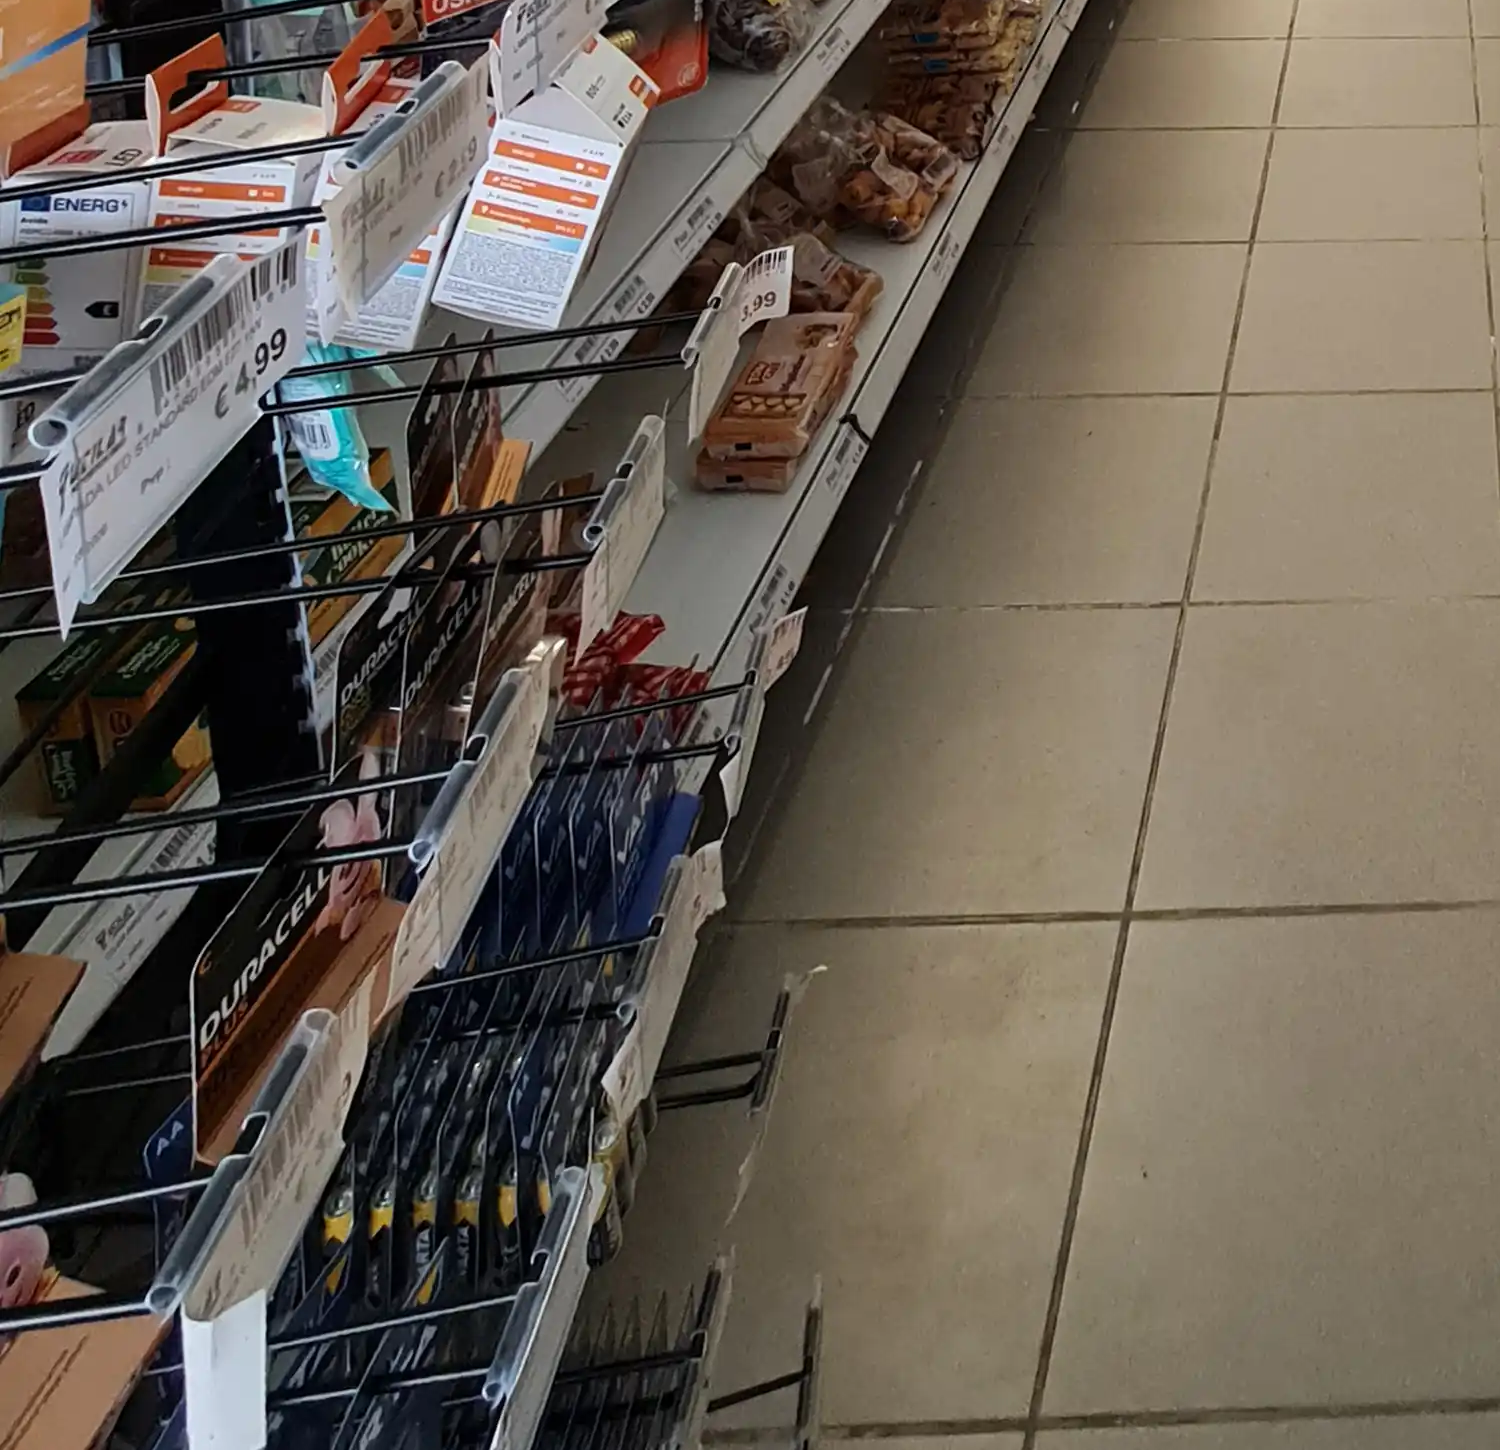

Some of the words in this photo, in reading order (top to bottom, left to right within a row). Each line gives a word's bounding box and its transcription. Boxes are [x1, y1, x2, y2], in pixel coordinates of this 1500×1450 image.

[53, 197, 119, 214] ENERG
[214, 381, 230, 420] €
[233, 327, 288, 396] 4,99
[404, 585, 480, 709] DURACELL
[199, 864, 332, 1052] DURACELL
[200, 996, 250, 1065] PLUS
[156, 1119, 185, 1158] AA
